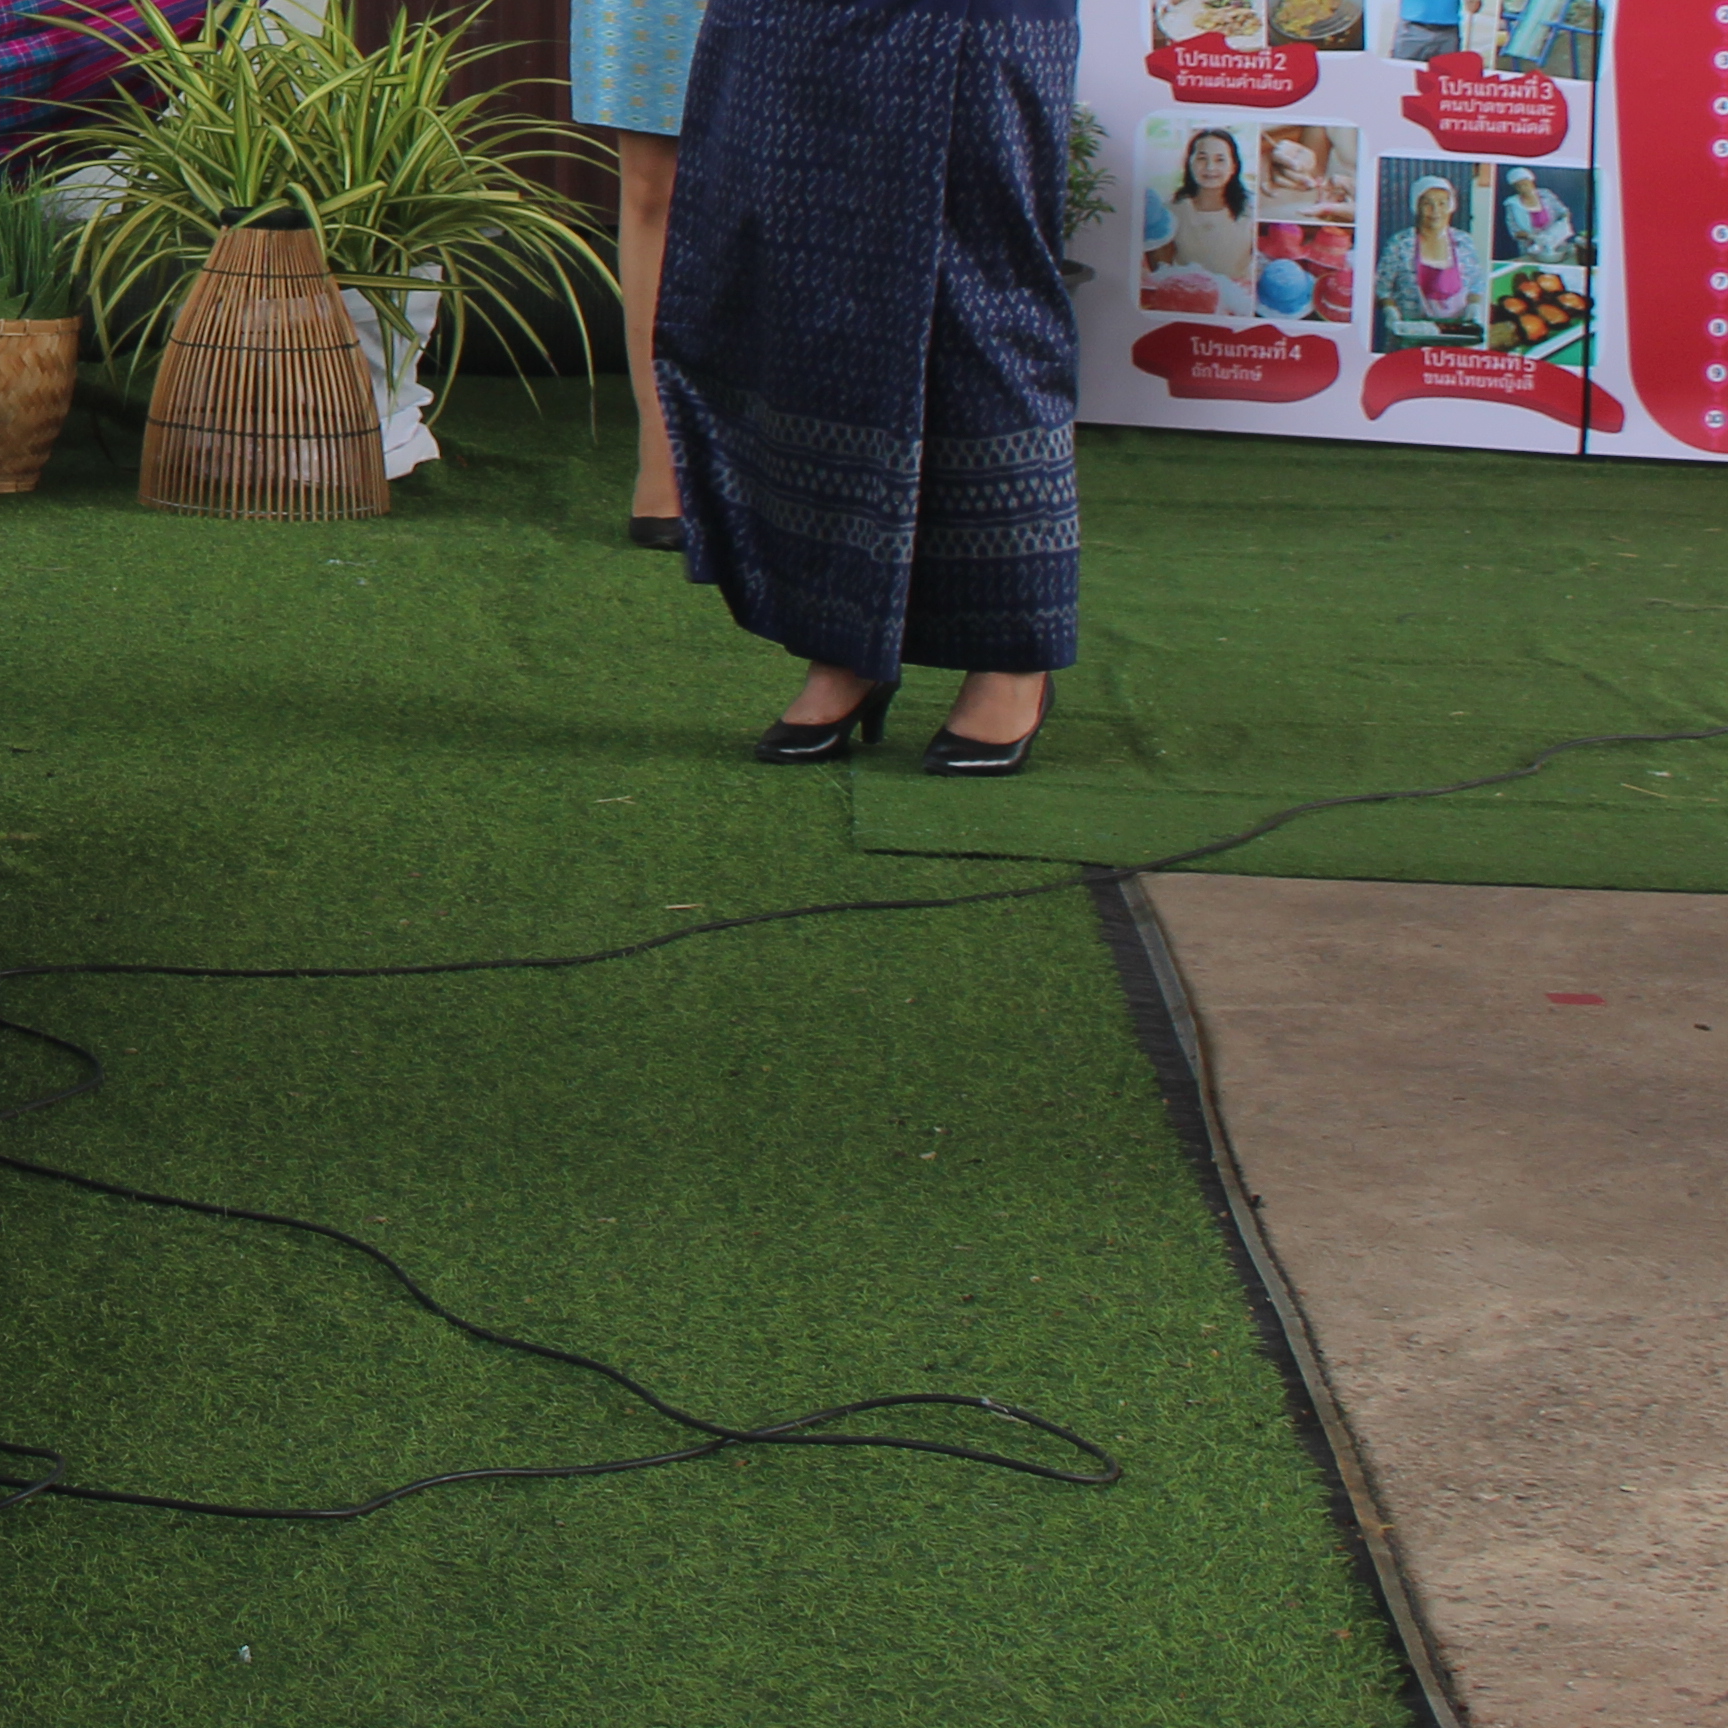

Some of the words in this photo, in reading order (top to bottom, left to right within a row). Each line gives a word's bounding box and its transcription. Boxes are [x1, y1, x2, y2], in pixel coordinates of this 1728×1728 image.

[1175, 47, 1271, 69] โปรแกรมที่
[1274, 54, 1286, 70] 2
[1439, 75, 1537, 98] โปรแกรมที่
[1541, 82, 1553, 99] 3
[1190, 336, 1286, 359] โปรแกรมที่
[1289, 345, 1301, 360] 4
